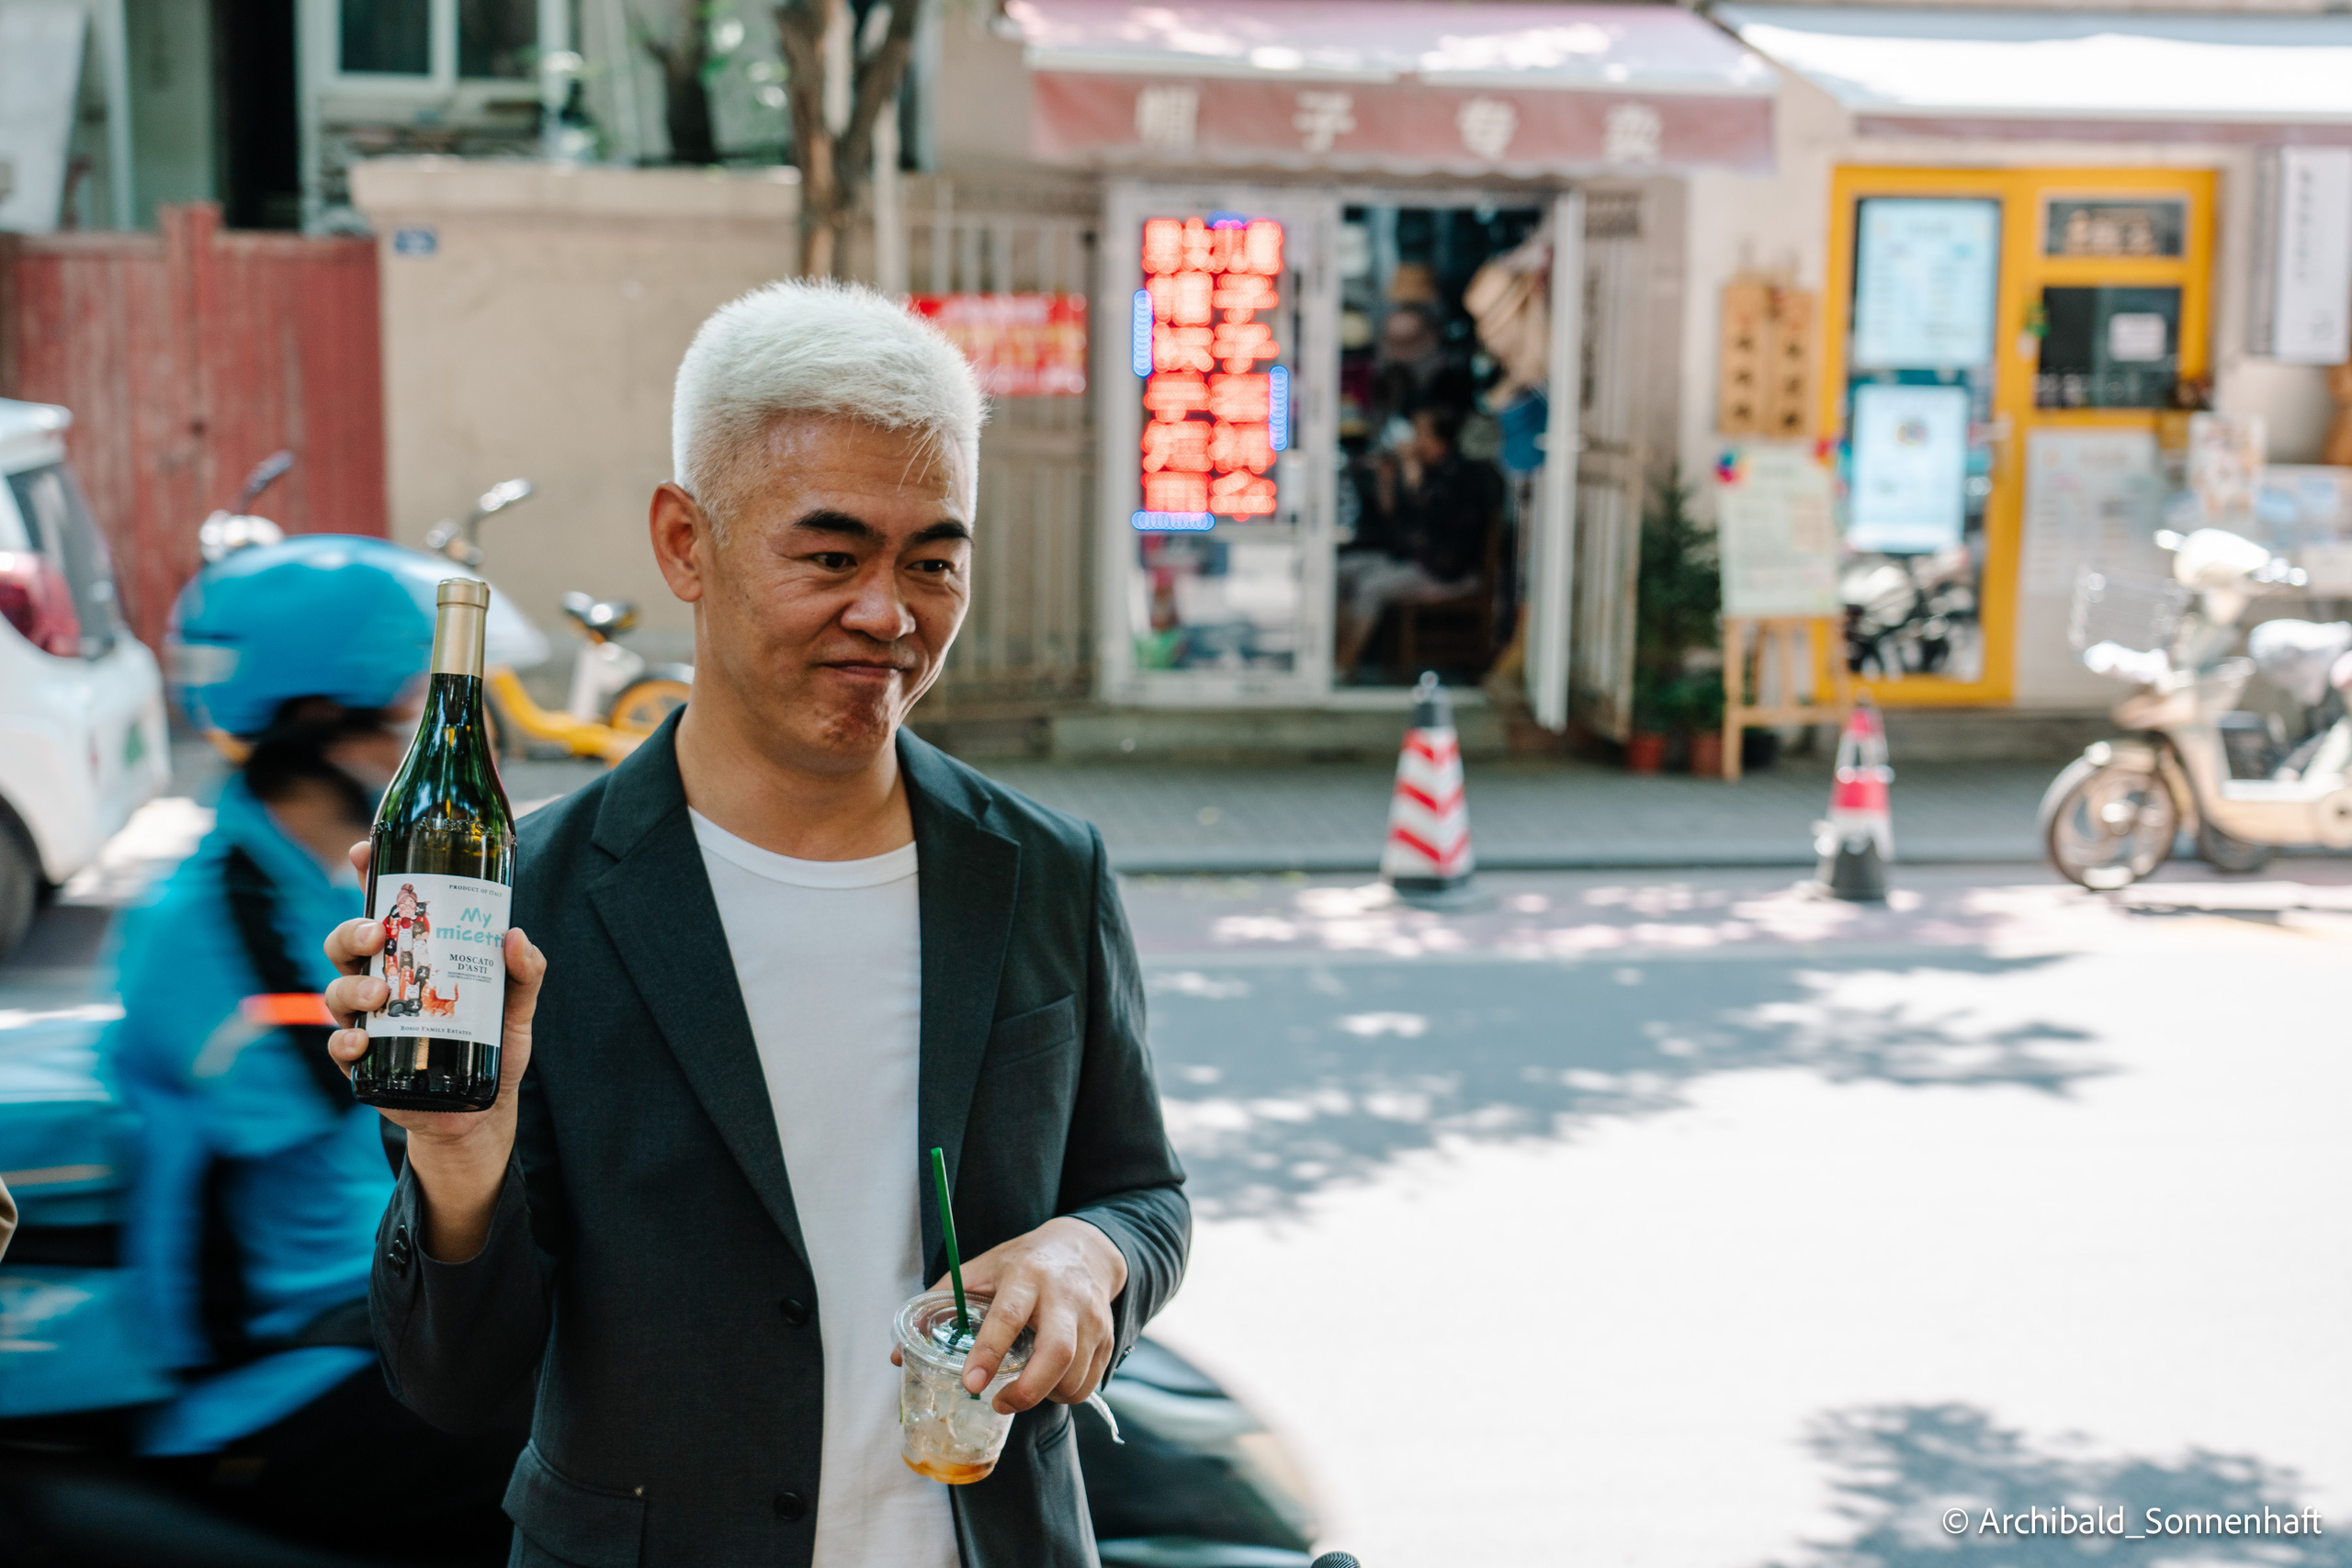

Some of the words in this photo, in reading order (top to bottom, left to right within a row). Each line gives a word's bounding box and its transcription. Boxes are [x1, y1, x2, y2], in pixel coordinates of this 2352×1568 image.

[448, 884, 480, 893] PRODUCT
[460, 907, 492, 929] My
[435, 925, 504, 949] micetti
[449, 953, 494, 967] MOSCATO
[458, 963, 488, 975] D'ASTI
